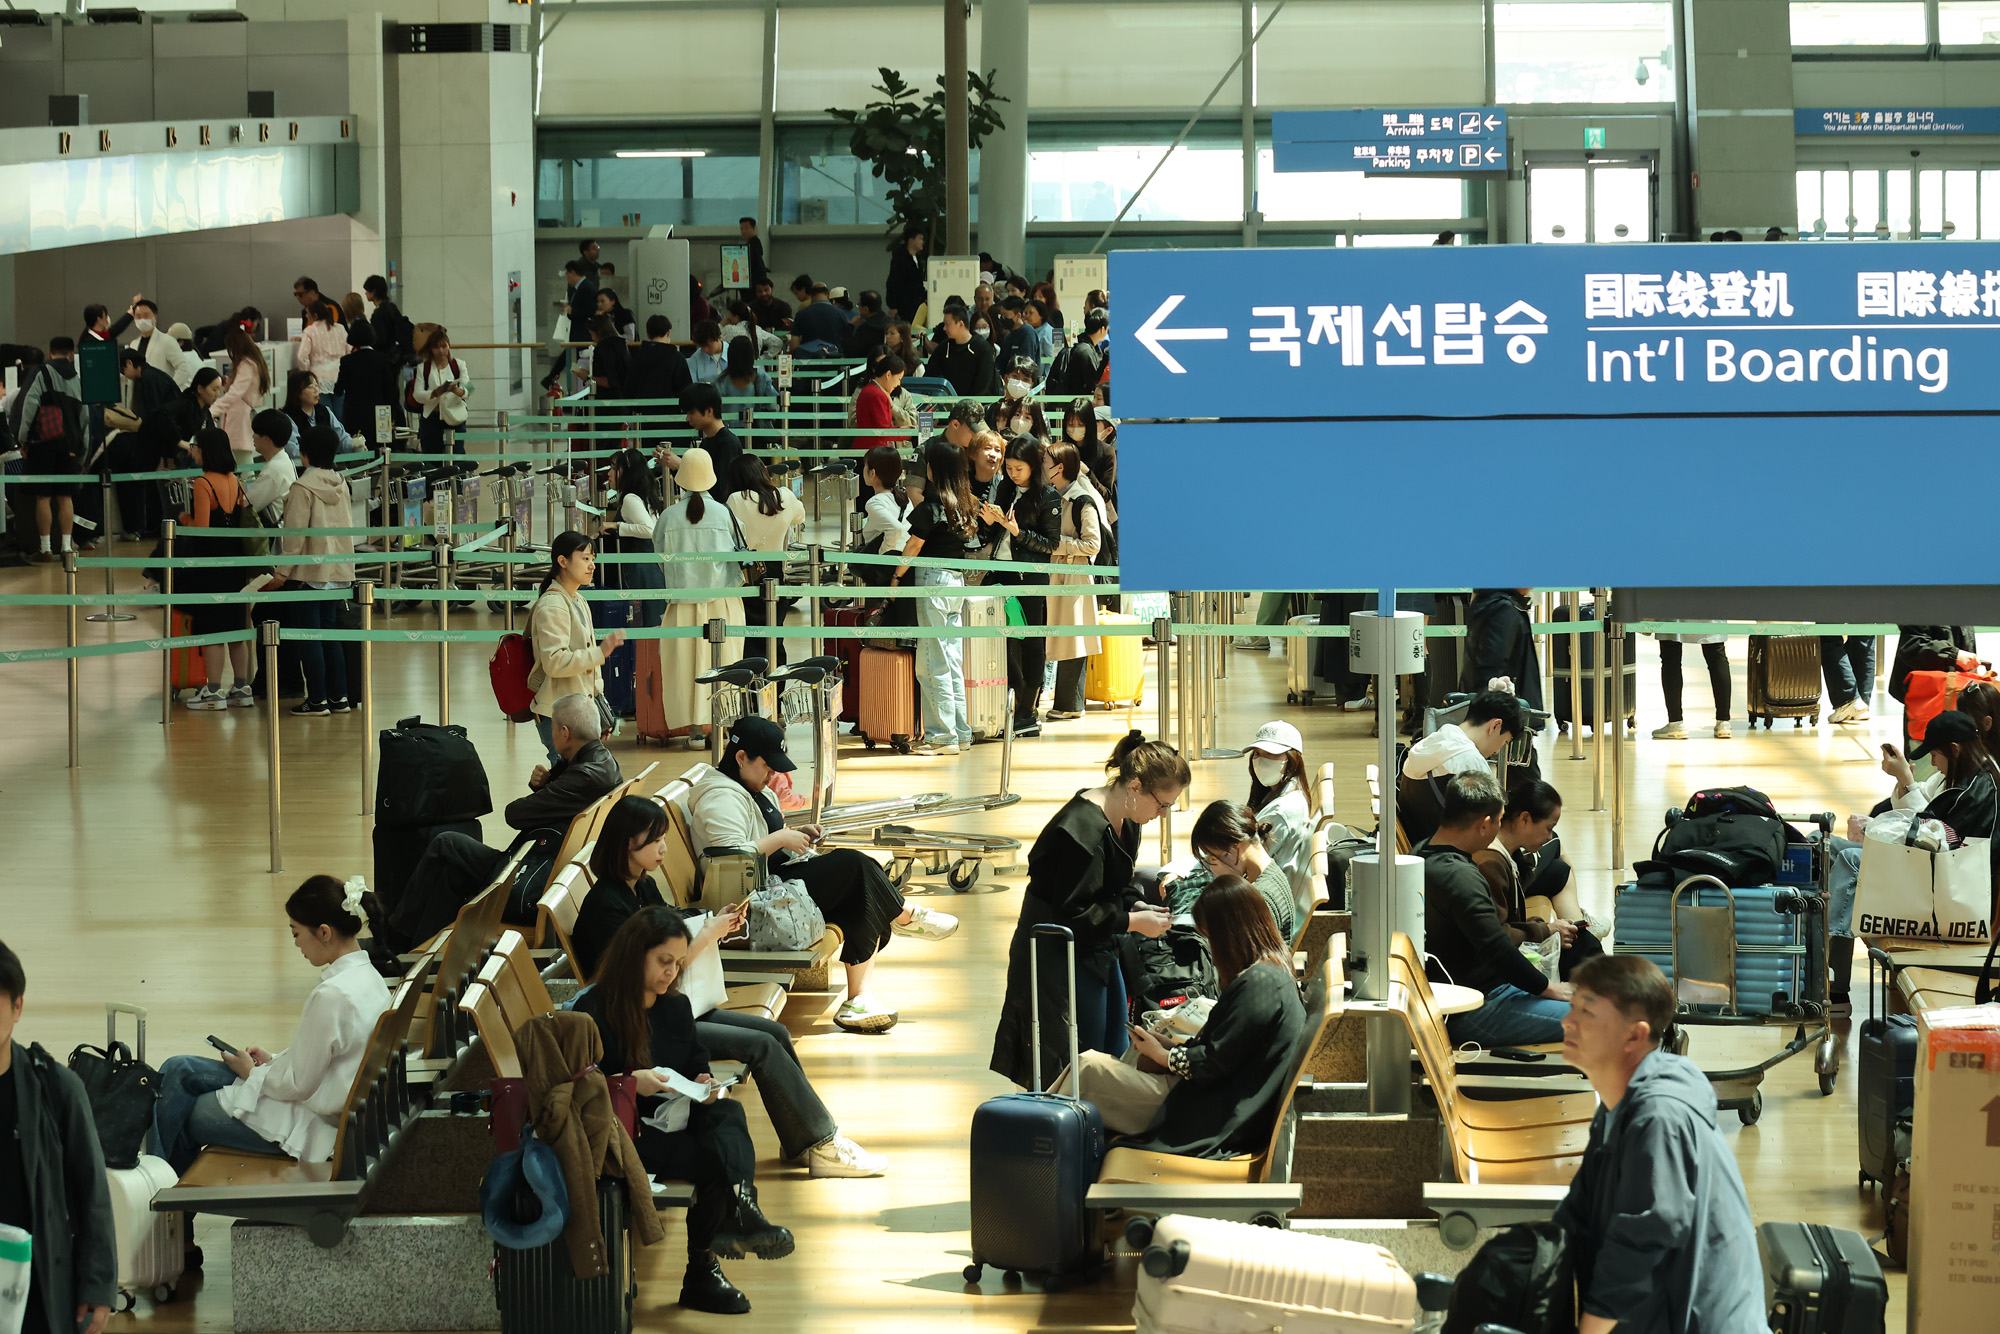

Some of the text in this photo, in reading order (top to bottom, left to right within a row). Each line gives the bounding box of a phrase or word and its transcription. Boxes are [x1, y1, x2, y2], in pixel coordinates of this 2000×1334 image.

[1385, 125, 1425, 137] Arrivals
[1429, 116, 1454, 131] 도착
[1372, 157, 1411, 170] Parking
[1416, 148, 1454, 164] 주차장
[1584, 271, 1794, 320] 国际线登机
[1249, 300, 1549, 367] 국제선탑승
[1587, 335, 1949, 394] Int'l Boarding
[185, 637, 205, 645] Airport
[446, 633, 466, 641] Airport
[1859, 913, 1989, 939] GENERAL IDEA
[1951, 1201, 1976, 1211] COLOR
